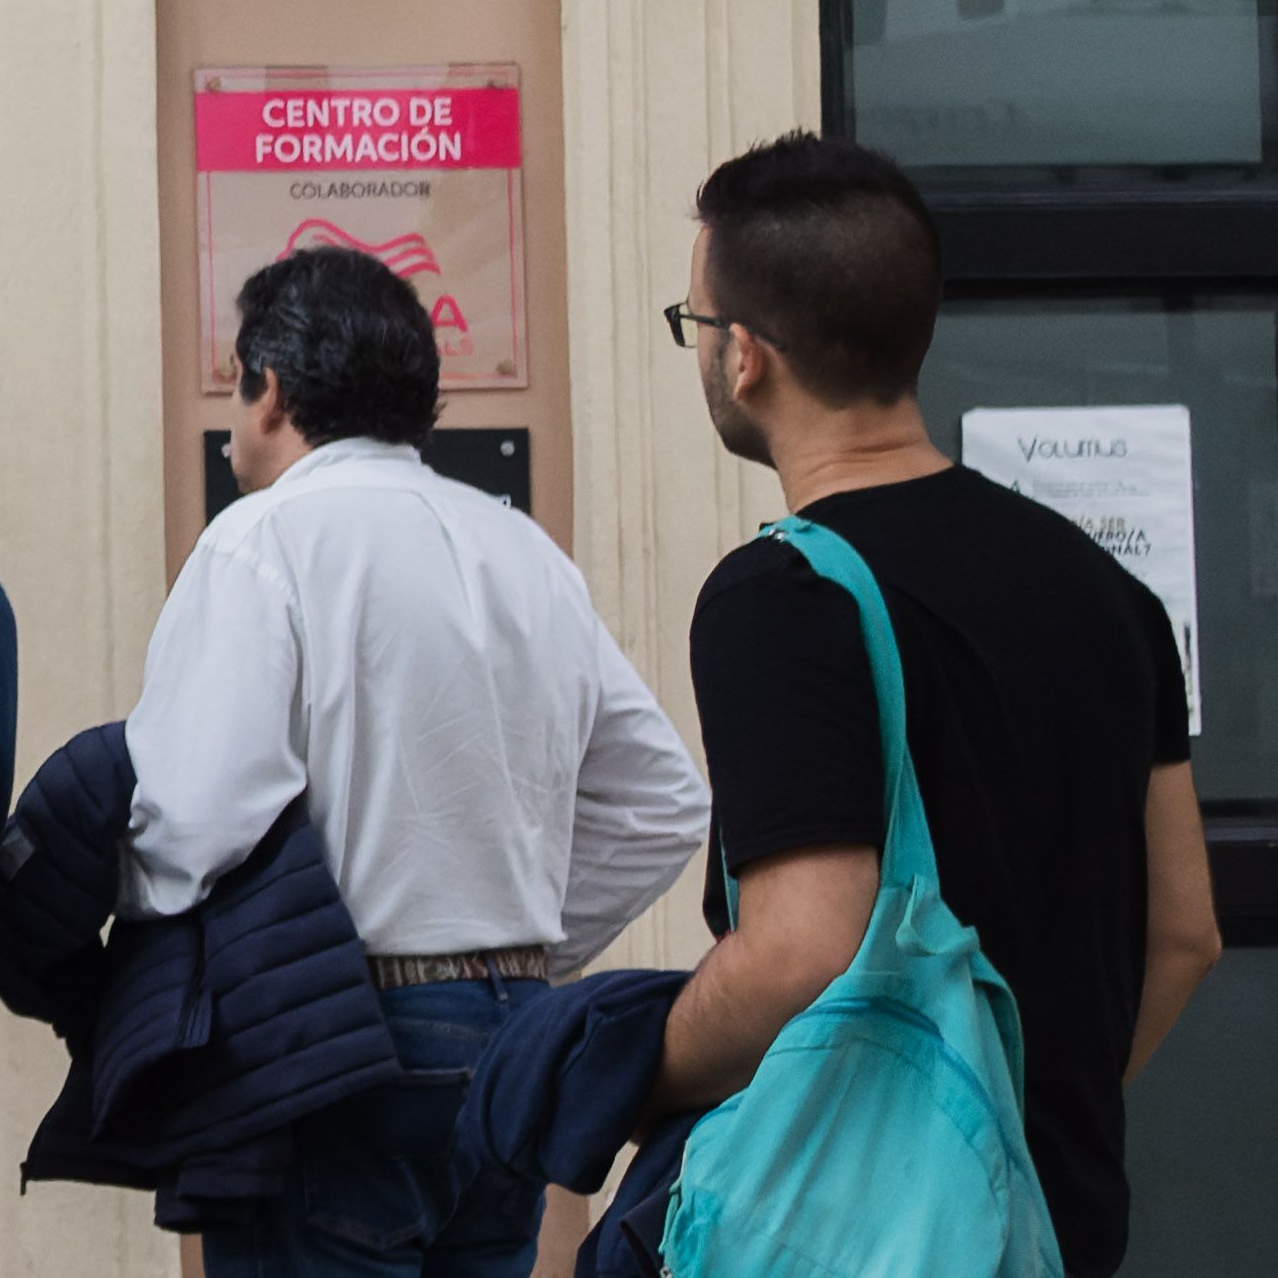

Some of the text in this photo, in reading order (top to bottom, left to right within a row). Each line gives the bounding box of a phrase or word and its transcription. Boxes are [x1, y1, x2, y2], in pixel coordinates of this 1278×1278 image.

[262, 96, 454, 128] CENTRO DE
[255, 126, 463, 164] FORMACIÓN
[289, 178, 433, 201] COLABORADOR
